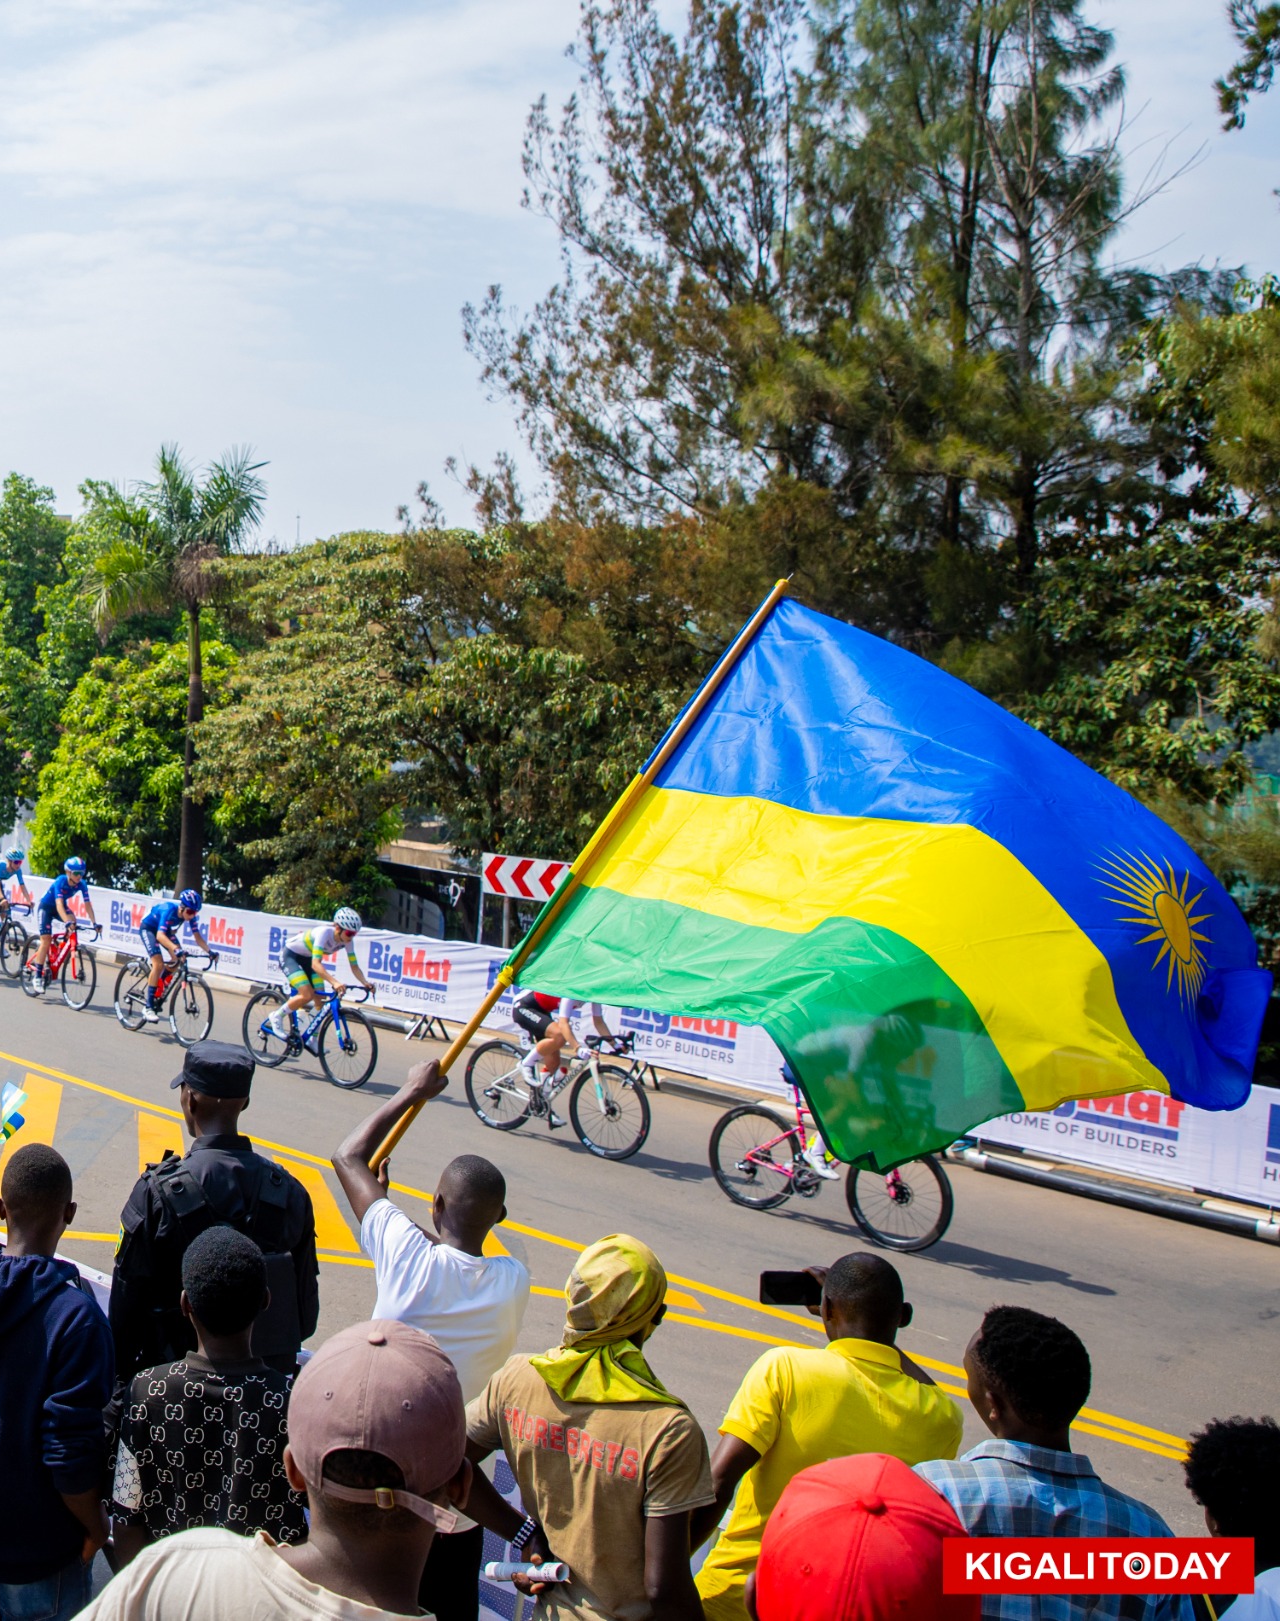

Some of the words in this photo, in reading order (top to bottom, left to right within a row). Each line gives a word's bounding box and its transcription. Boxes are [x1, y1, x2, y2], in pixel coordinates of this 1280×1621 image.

[111, 900, 145, 932] BigM
[183, 915, 244, 947] BgMat
[368, 941, 451, 983] BigMat
[372, 983, 390, 993] OME
[391, 986, 404, 997] OF
[405, 987, 447, 1004] BUILDERS
[489, 1005, 511, 1017] OME
[619, 1029, 652, 1046] HME
[655, 1038, 672, 1050] OF
[674, 1042, 735, 1064] BUILDERS
[1055, 1121, 1080, 1136] OF
[1084, 1127, 1178, 1159] BUILDERS
